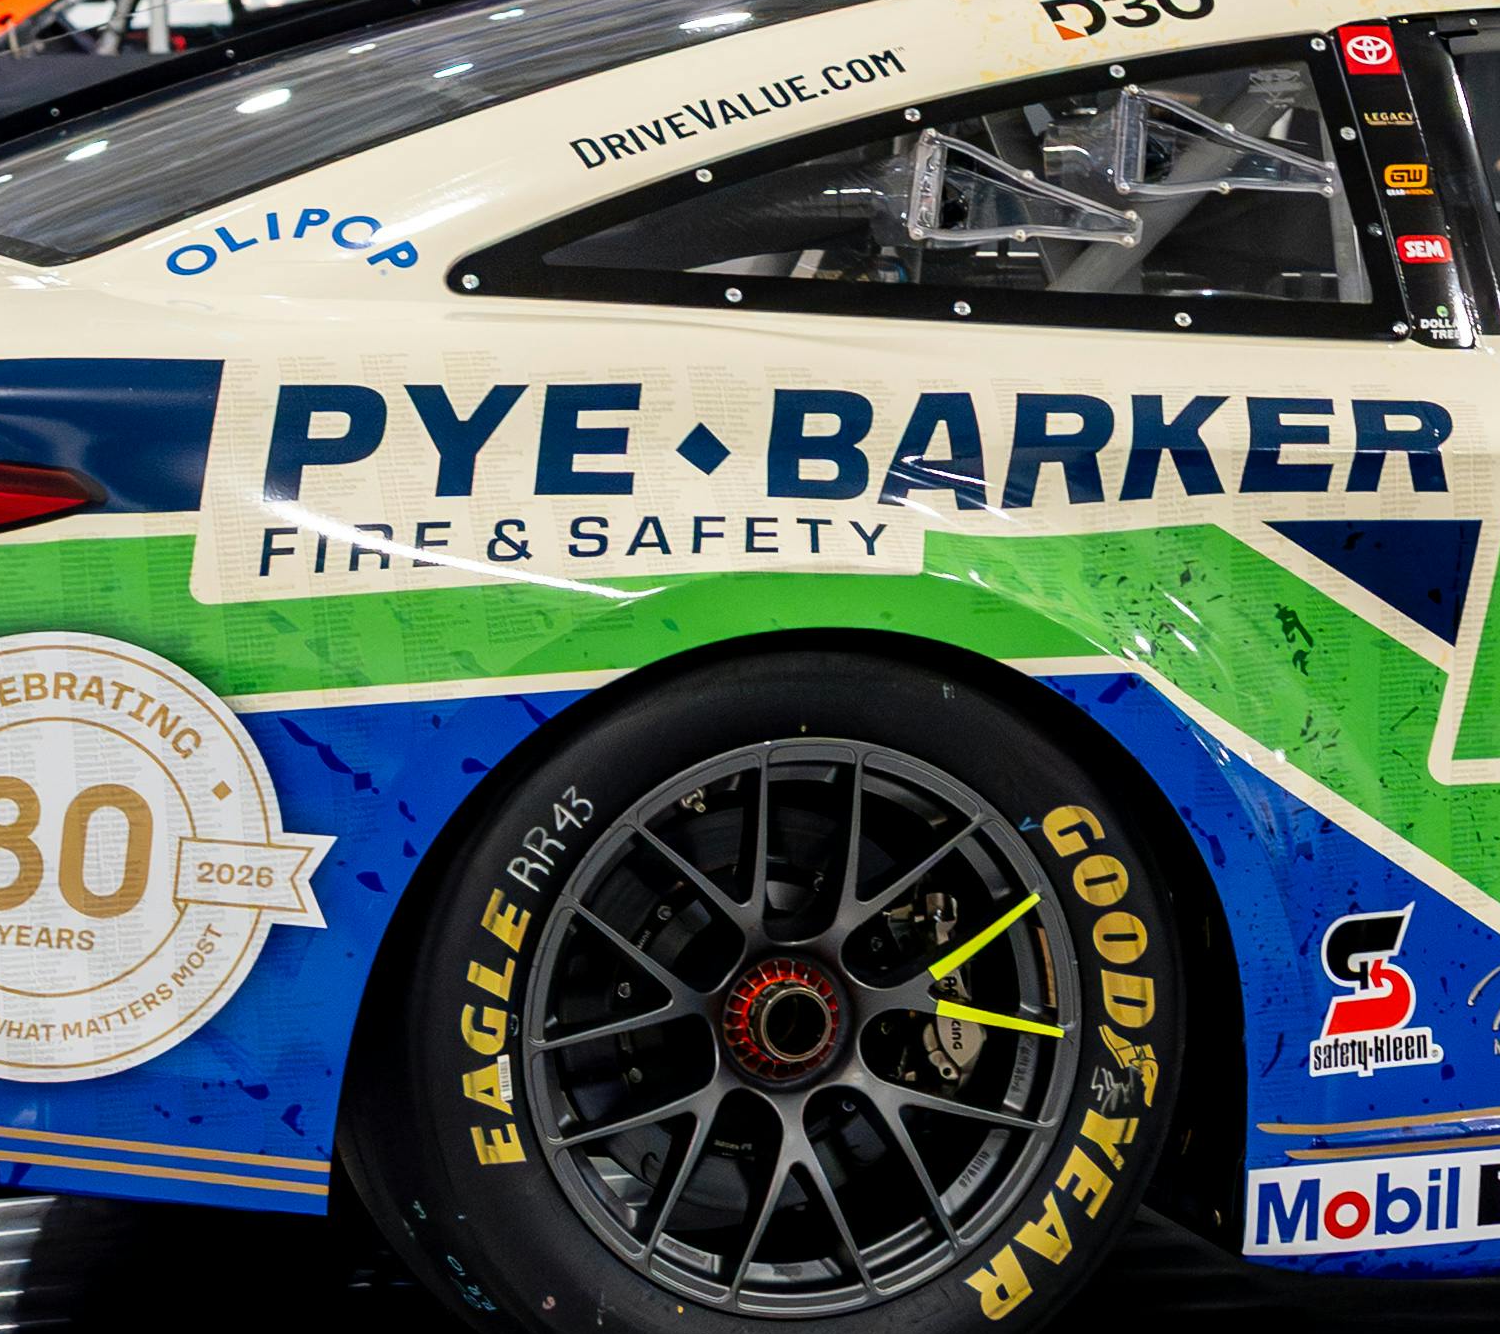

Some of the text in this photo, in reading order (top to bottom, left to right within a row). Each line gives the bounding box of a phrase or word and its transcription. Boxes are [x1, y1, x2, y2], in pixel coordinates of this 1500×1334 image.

[1363, 111, 1414, 123] LEGACY
[166, 208, 419, 276] OLIPOP
[1404, 240, 1445, 259] SEM
[263, 384, 1453, 510] PYE BARKER
[259, 514, 888, 577] FIRE & SAFETY
[196, 861, 275, 888] 2026
[62, 983, 174, 1042] MATTERS
[171, 923, 224, 994] MOST
[461, 888, 532, 1165] EAGLE
[965, 805, 1157, 1321] GOODYEAR
[1256, 1166, 1461, 1246] Mobil
